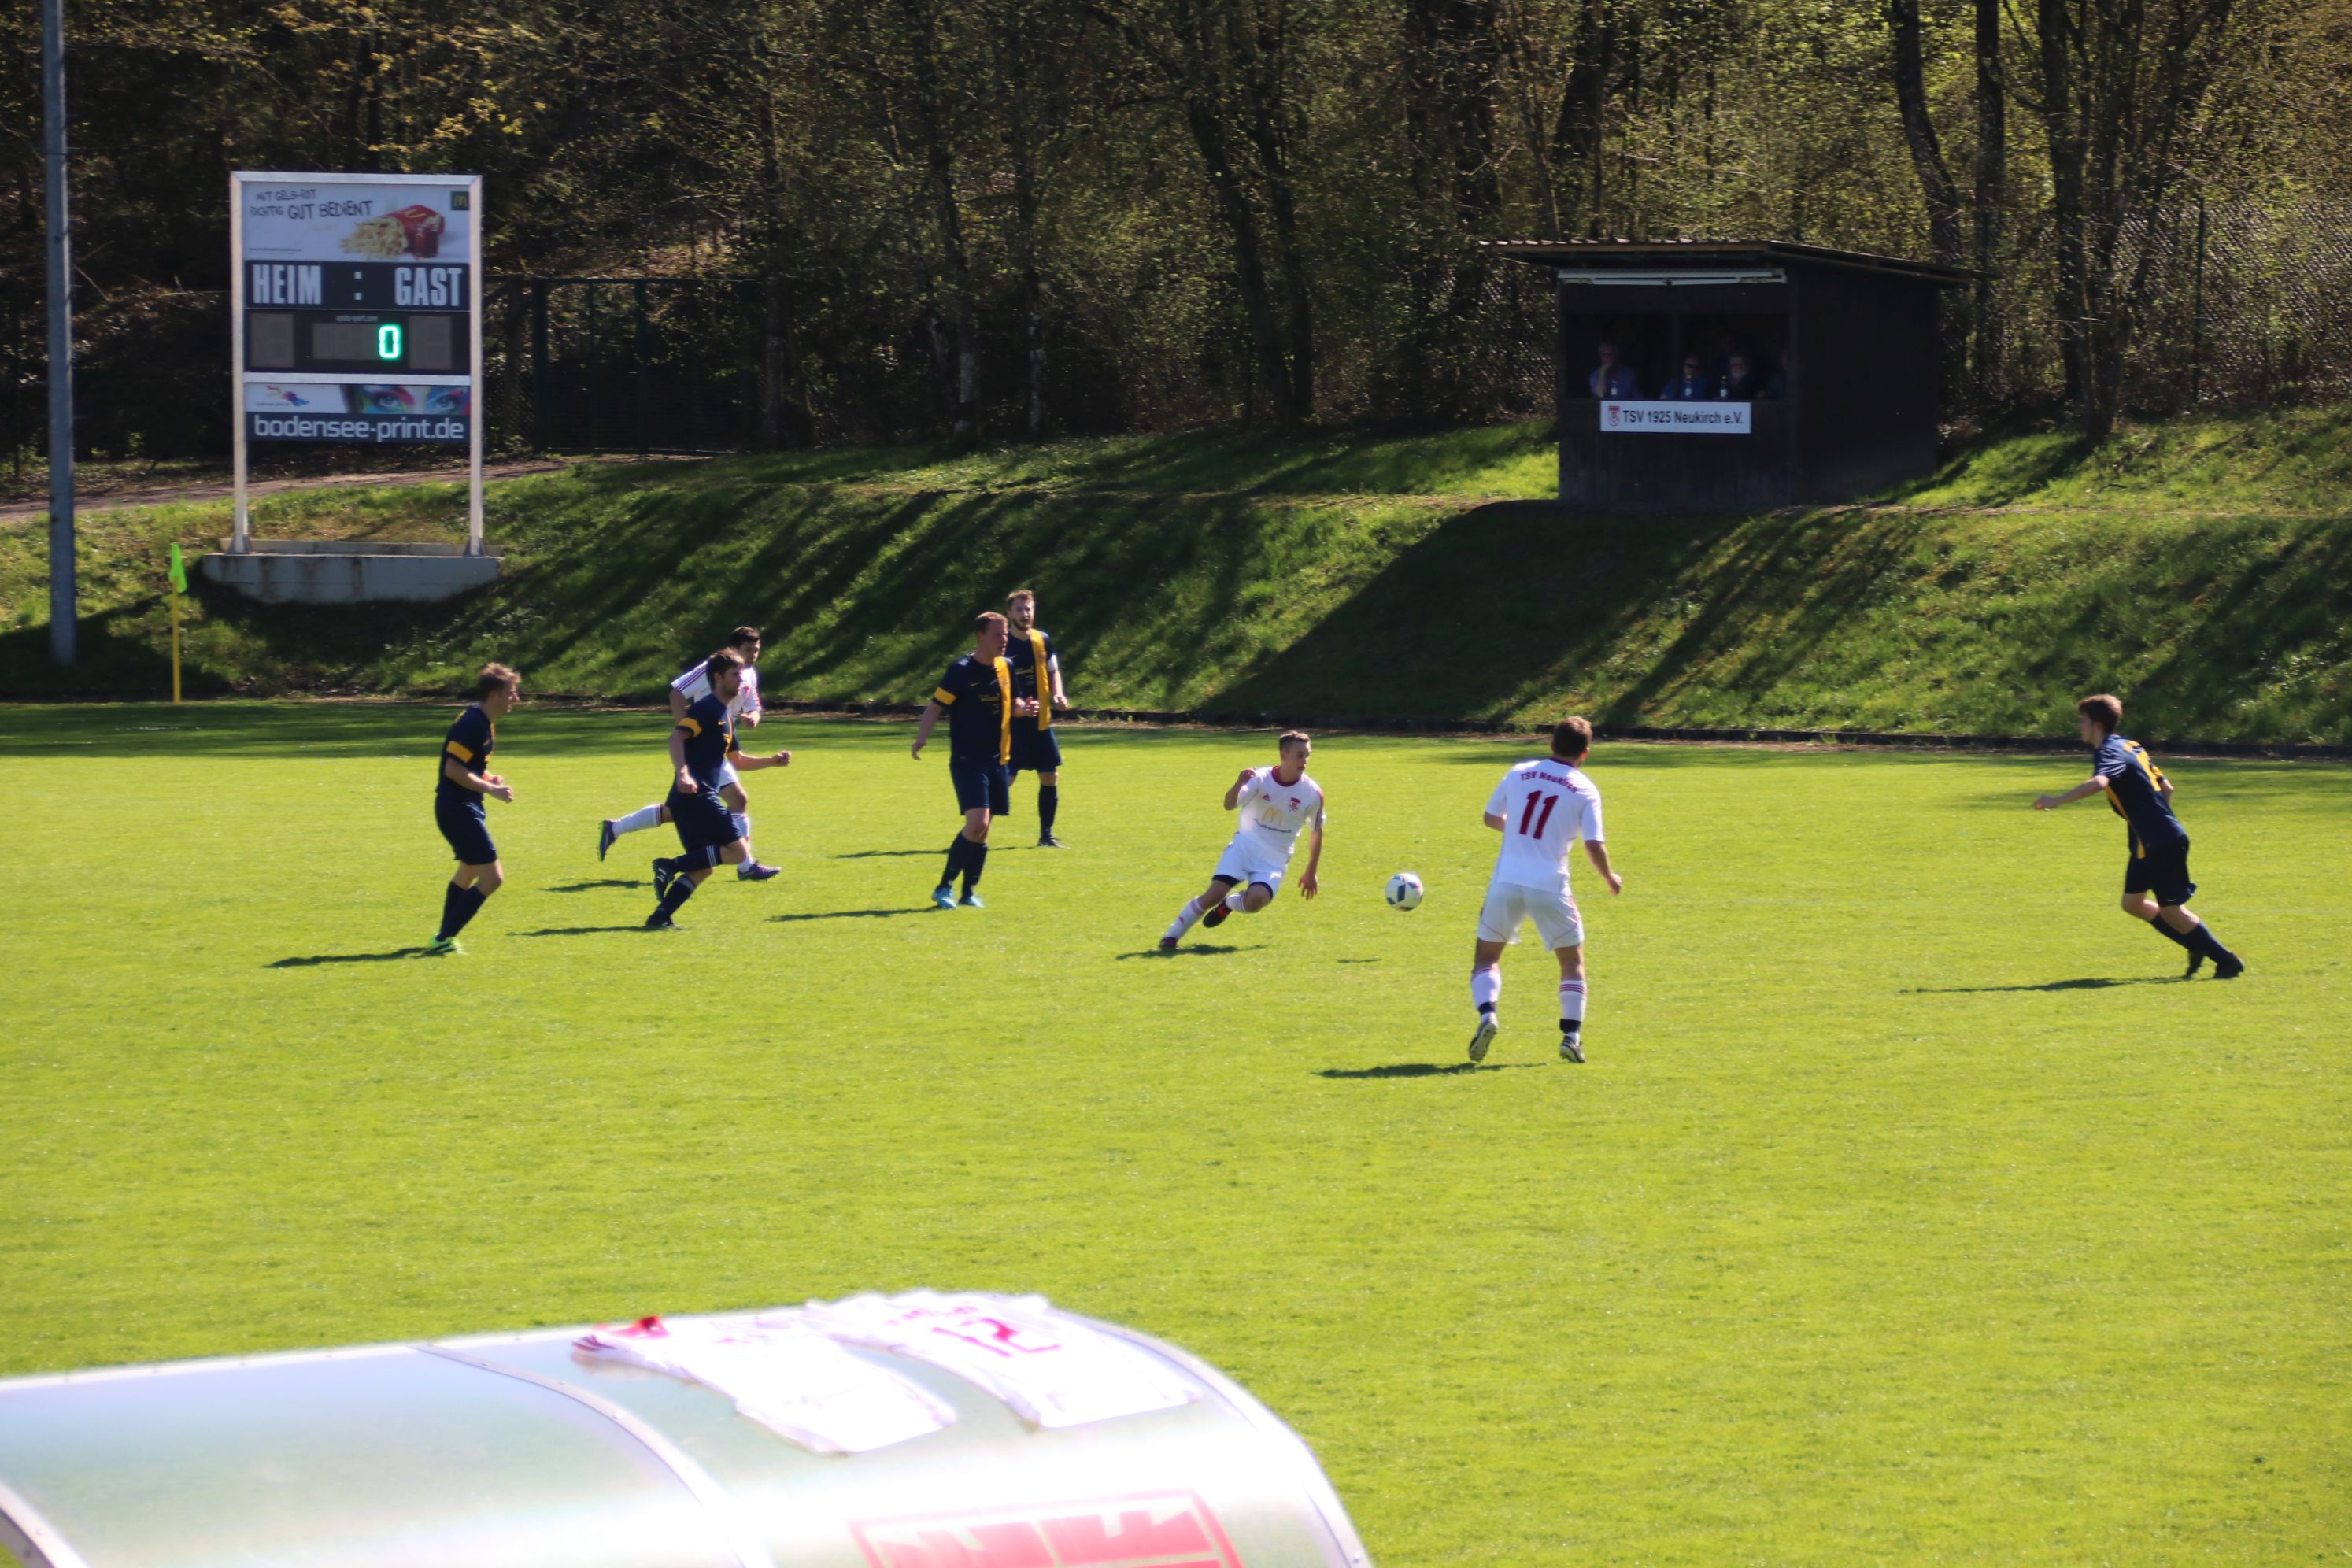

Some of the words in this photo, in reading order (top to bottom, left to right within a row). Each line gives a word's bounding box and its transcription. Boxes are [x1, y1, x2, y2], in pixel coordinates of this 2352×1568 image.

[288, 204, 314, 219] GUT
[320, 200, 372, 217] BEDIENT
[253, 264, 321, 305] HEIM
[395, 268, 462, 306] GAST
[379, 324, 400, 359] 0
[254, 416, 464, 442] bodensee-print.de
[1623, 410, 1644, 423] TSV
[1648, 411, 1671, 423] 1925
[1674, 411, 1721, 423] Neukirch
[1725, 412, 1743, 423] e.V.
[1520, 771, 1537, 781] TSV
[1539, 772, 1577, 793] Neukirch
[1519, 790, 1559, 839] 11
